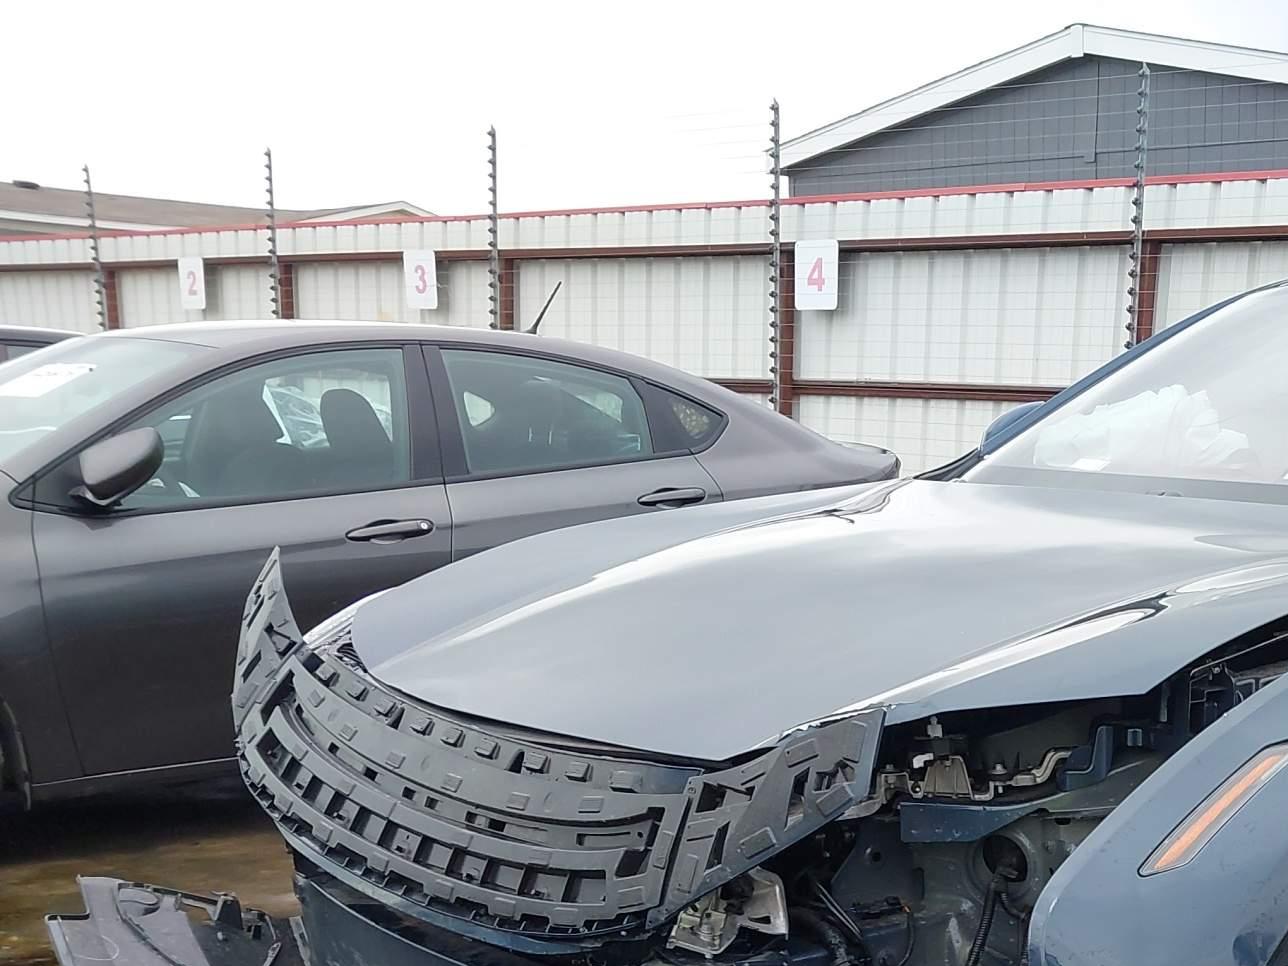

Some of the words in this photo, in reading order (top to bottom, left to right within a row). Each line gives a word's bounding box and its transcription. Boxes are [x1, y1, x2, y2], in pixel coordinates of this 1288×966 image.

[186, 270, 198, 296] 2
[414, 264, 428, 294] 3
[807, 257, 825, 291] 4
